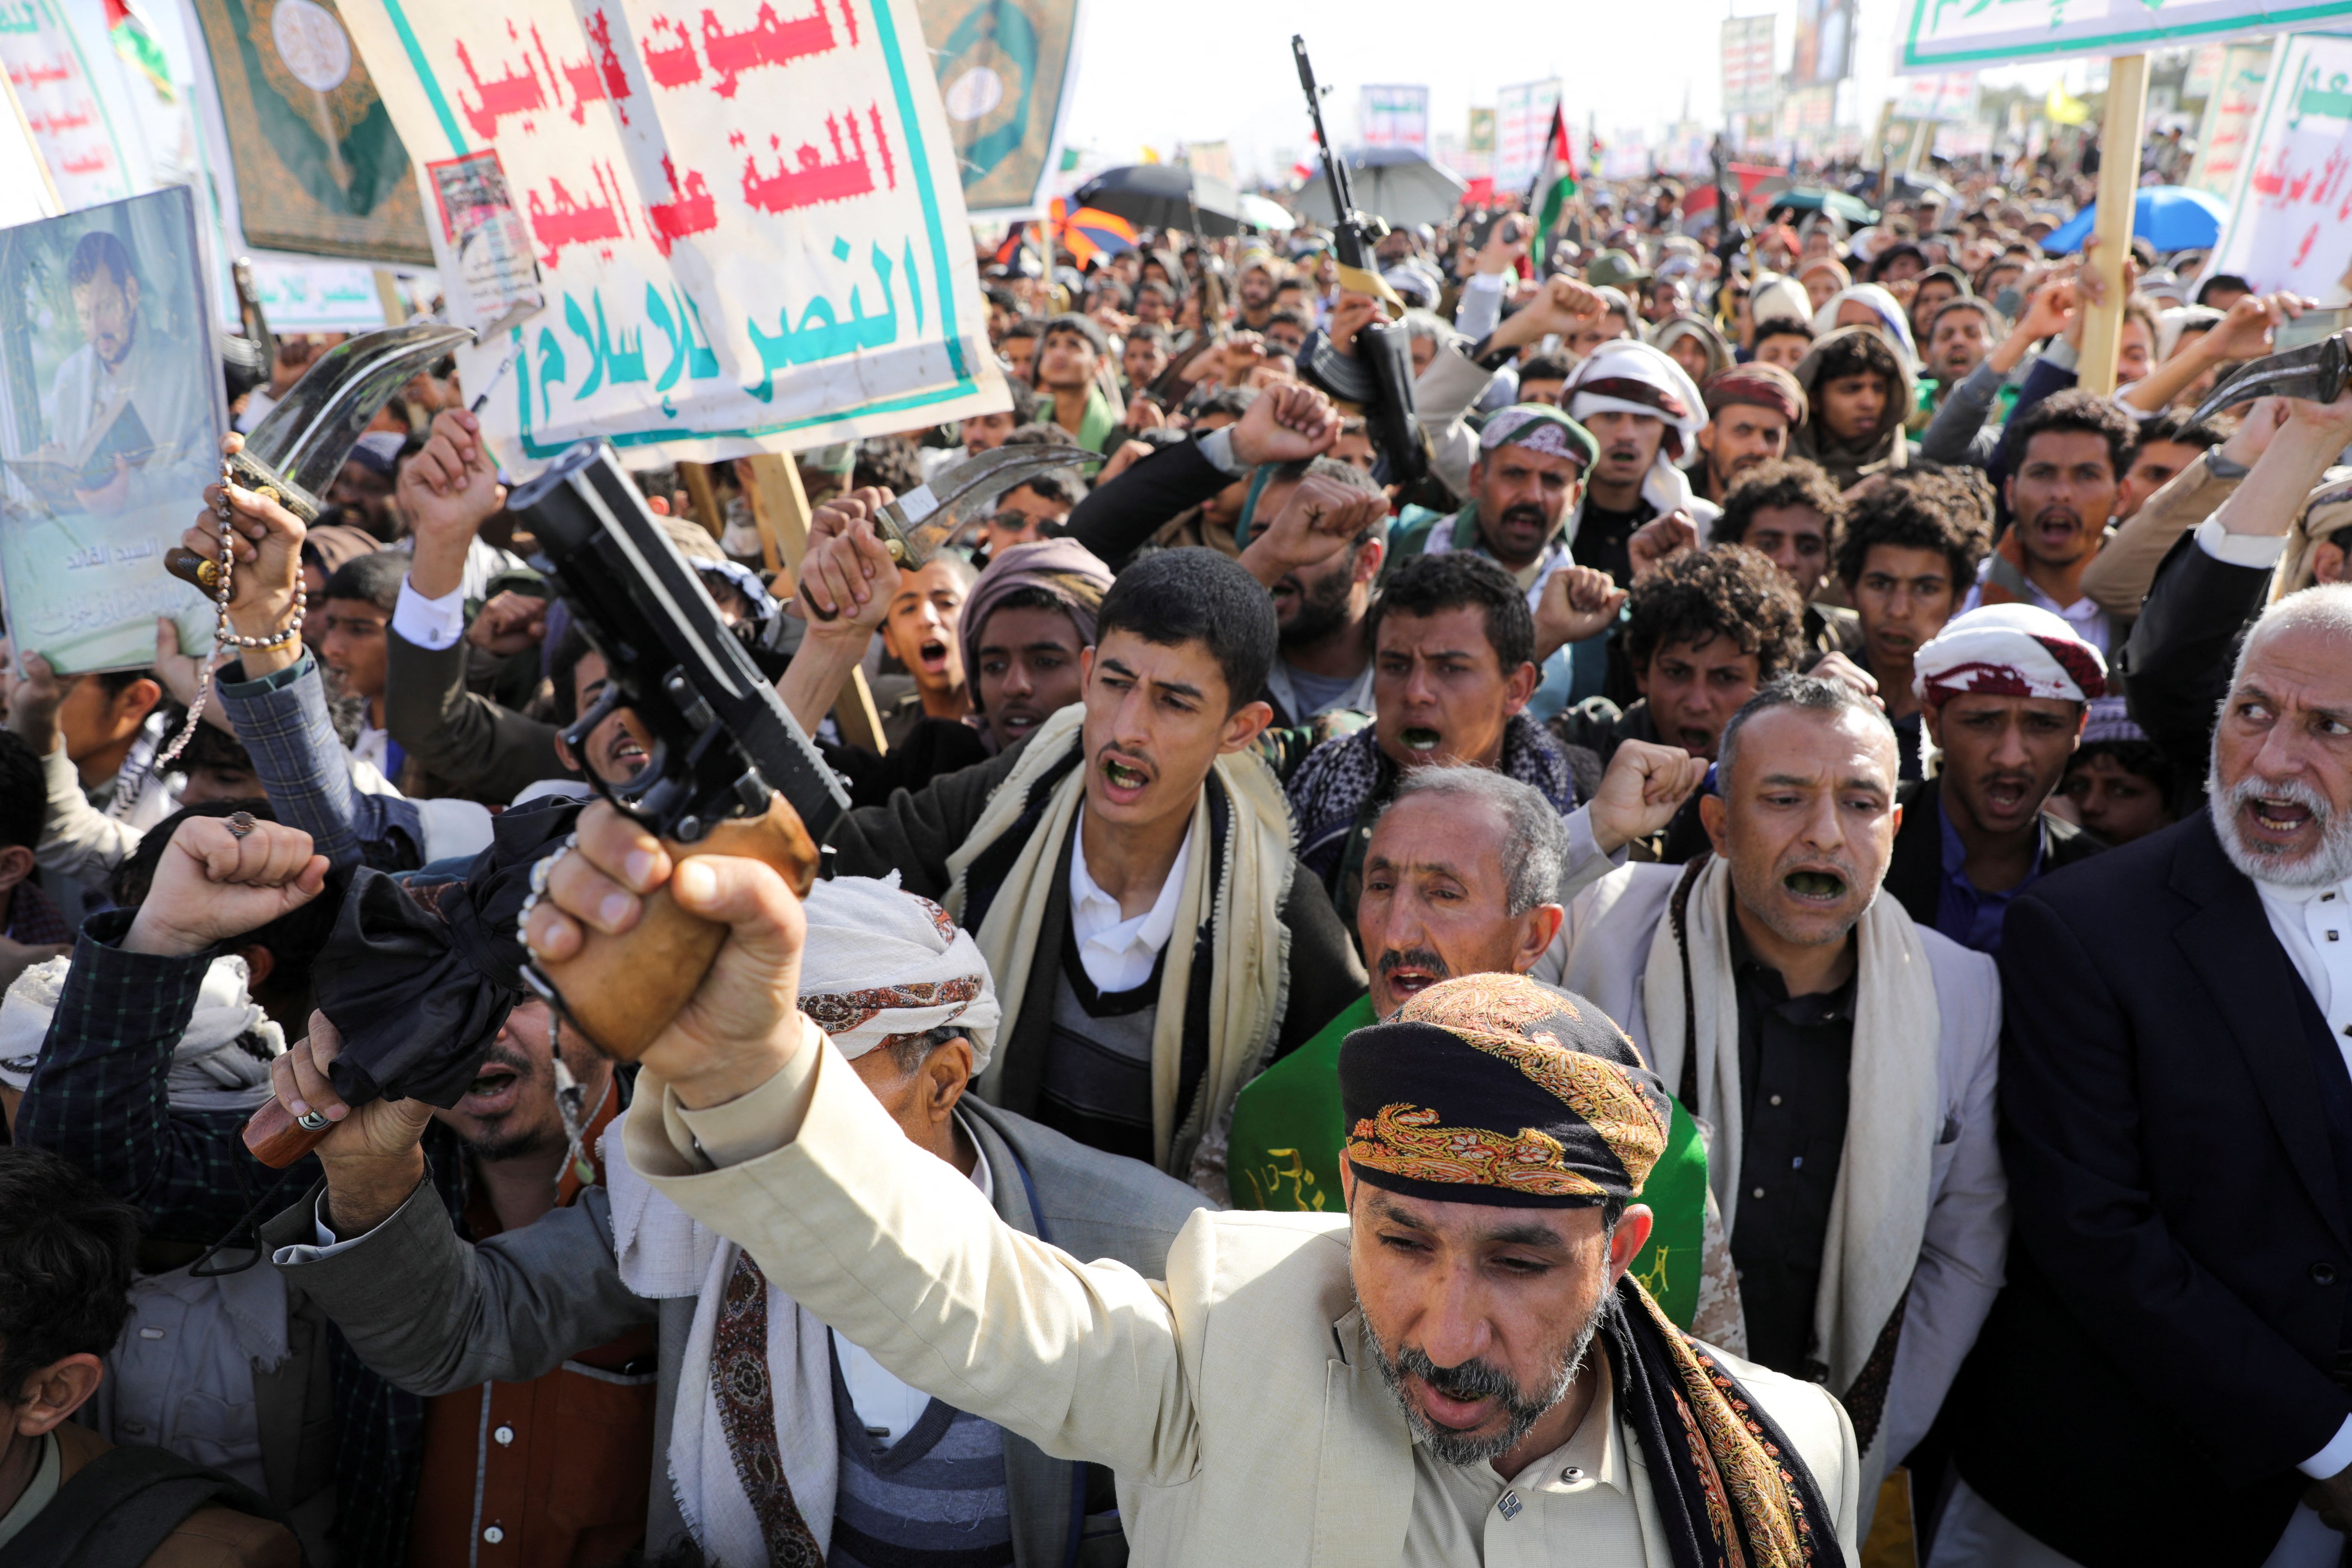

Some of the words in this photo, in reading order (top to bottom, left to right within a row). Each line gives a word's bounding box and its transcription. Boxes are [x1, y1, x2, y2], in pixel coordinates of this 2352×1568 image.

[641, 0, 858, 98] الموت
[529, 158, 635, 269] اليهود
[643, 153, 718, 259] على
[729, 104, 895, 214] اللعنة
[538, 283, 720, 421] للإسلام
[743, 237, 923, 404] النصر
